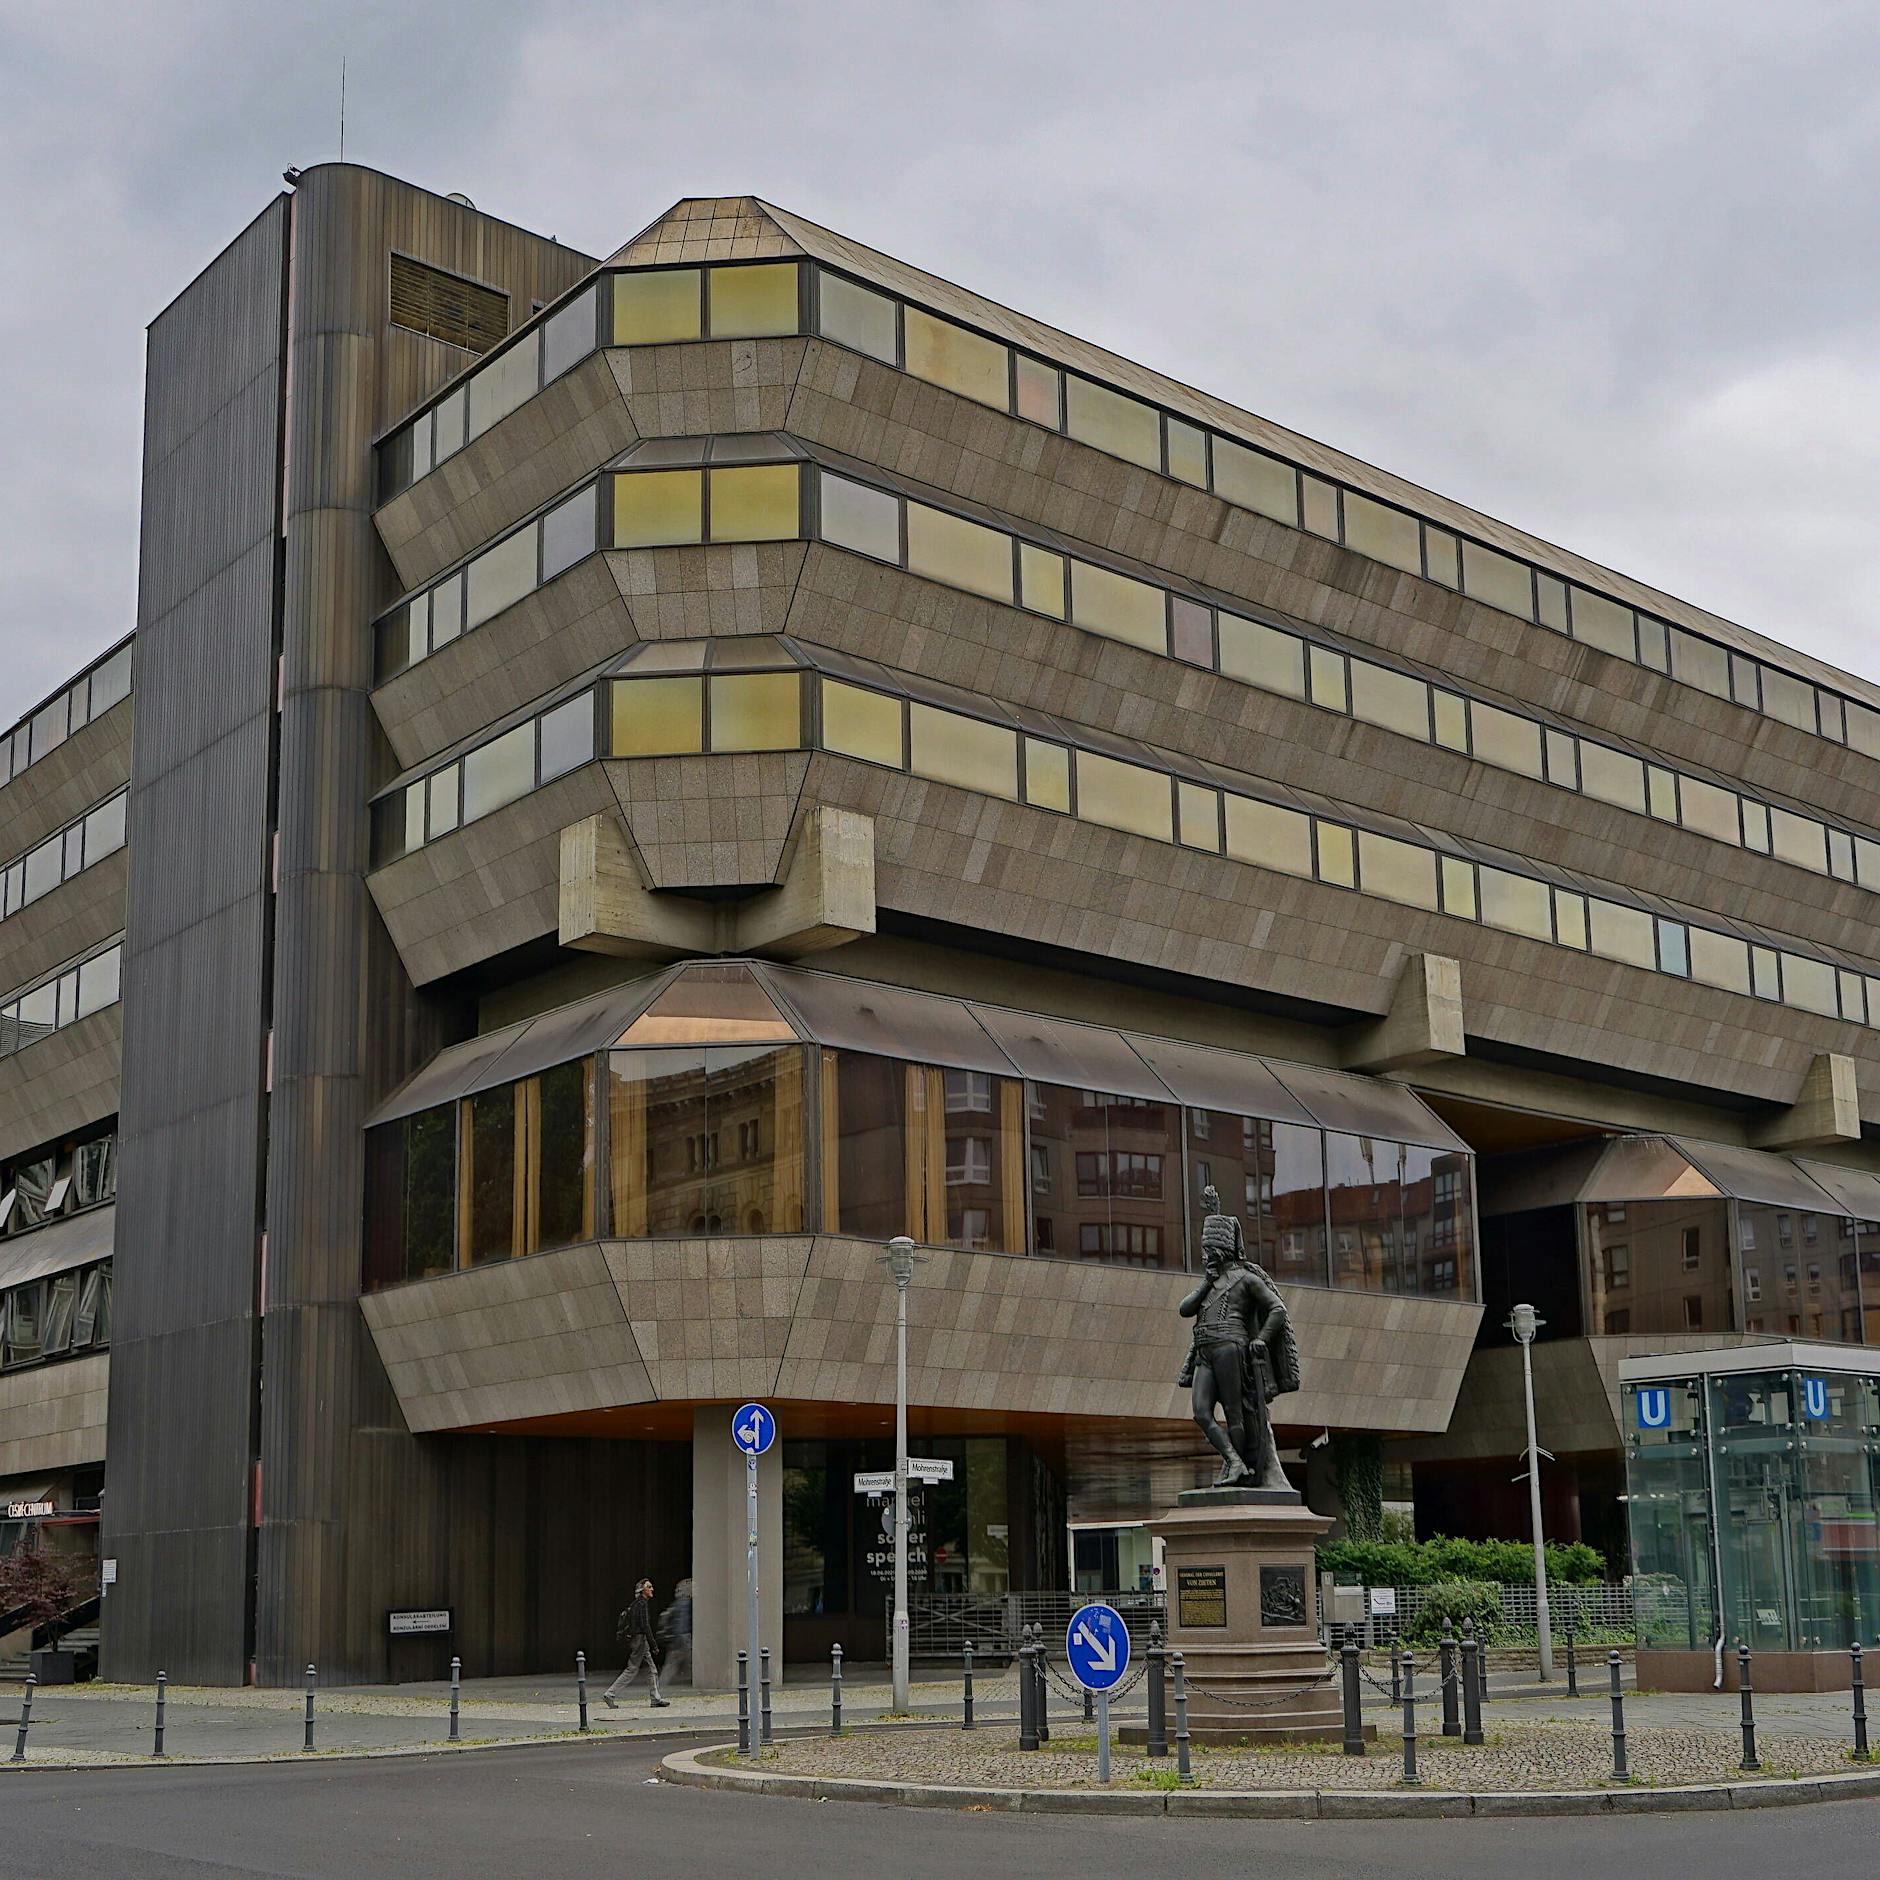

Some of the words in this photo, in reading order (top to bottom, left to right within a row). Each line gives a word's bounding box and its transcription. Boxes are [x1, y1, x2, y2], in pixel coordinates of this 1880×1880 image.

[1807, 1380, 1825, 1417] U
[1641, 1390, 1666, 1426] U
[912, 1463, 948, 1475] Mohrenstraße
[858, 1476, 892, 1487] Mohrenstraße
[866, 1490, 925, 1508] mael
[877, 1532, 927, 1545] soer
[866, 1546, 927, 1567] spech
